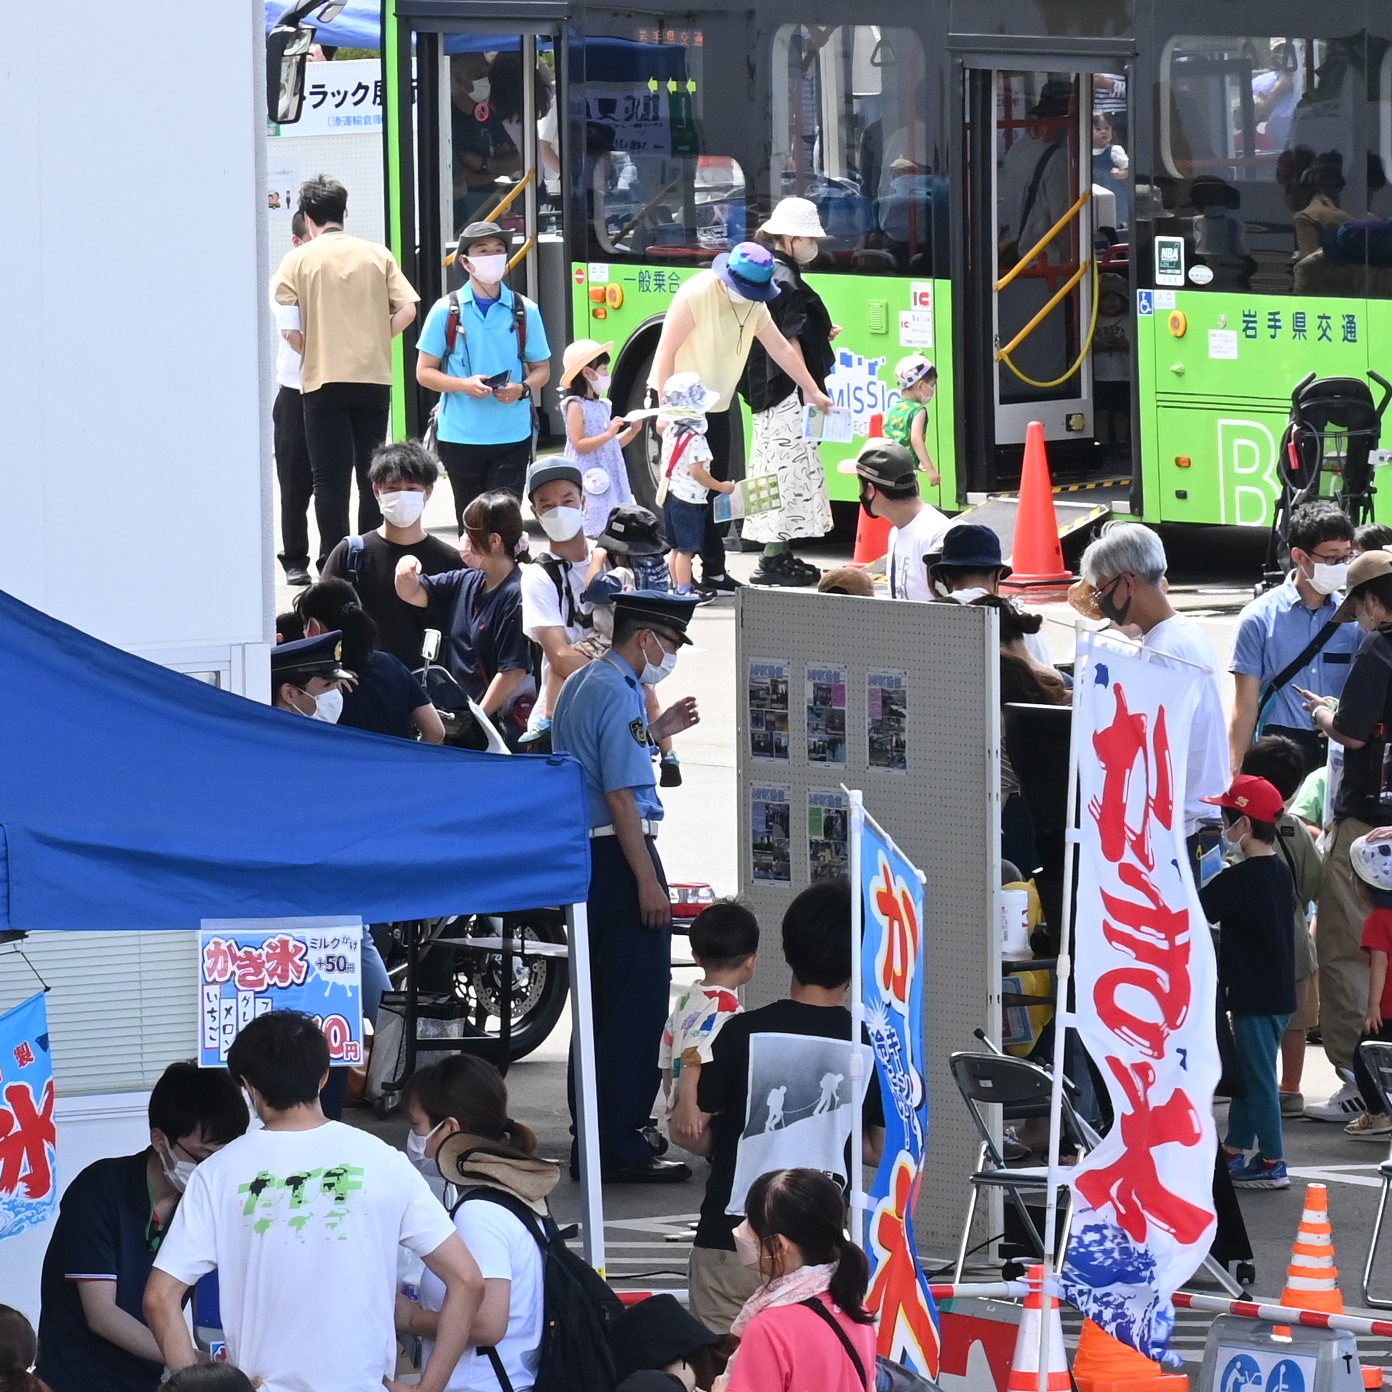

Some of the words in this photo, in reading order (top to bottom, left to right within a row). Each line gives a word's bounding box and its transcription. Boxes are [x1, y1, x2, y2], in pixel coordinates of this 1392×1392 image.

[623, 270, 681, 294] 一般乗合
[1242, 308, 1359, 344] 岩手県交通
[309, 935, 359, 950] ミルクかけ
[204, 935, 309, 991] かき氷
[315, 953, 356, 975] +50円
[1074, 682, 1216, 1246] かき氷
[205, 990, 219, 1042] いちご
